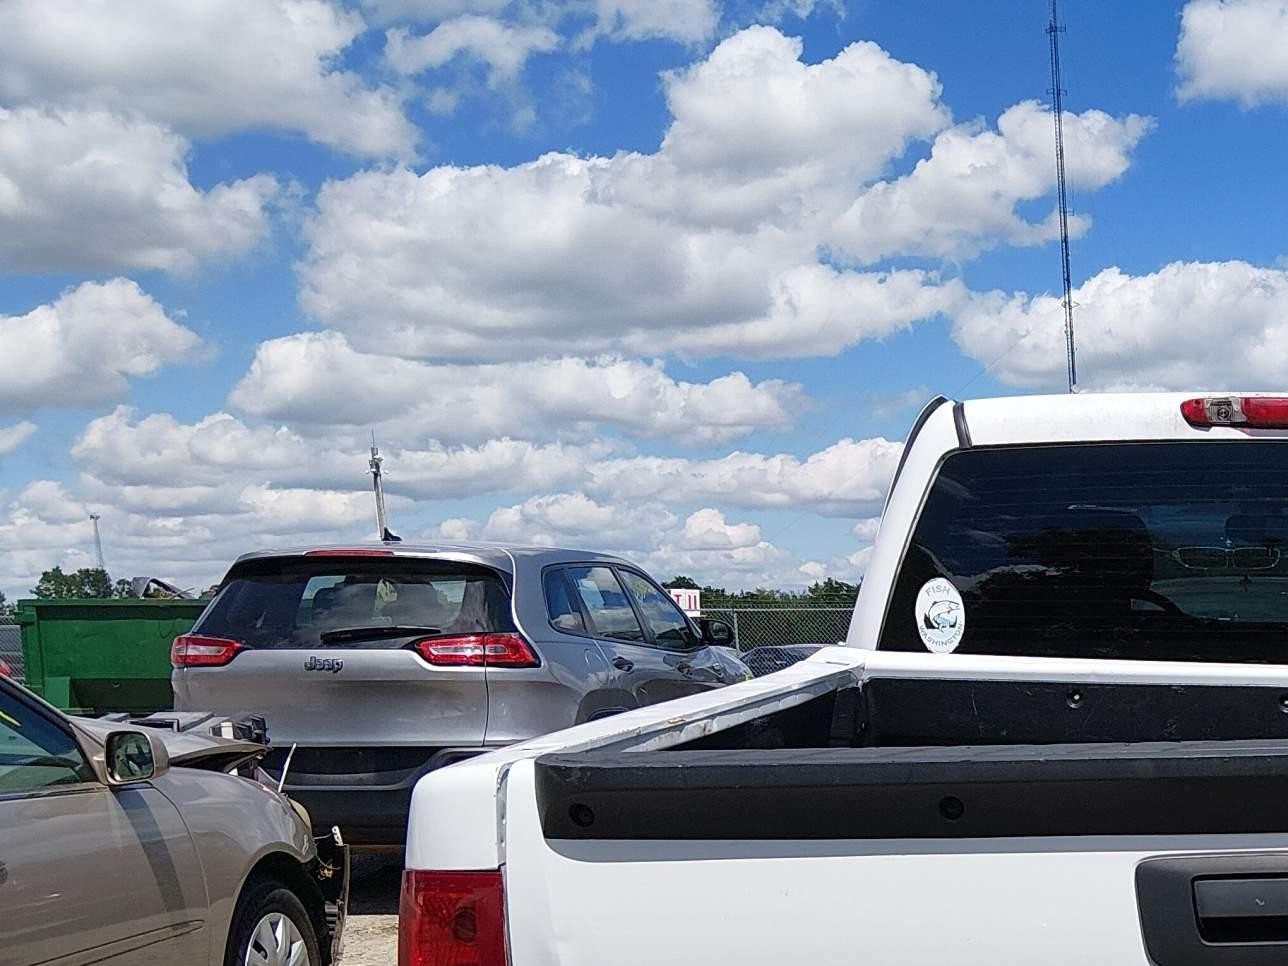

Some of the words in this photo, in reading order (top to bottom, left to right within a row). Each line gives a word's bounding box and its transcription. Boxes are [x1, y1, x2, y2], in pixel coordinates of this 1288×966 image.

[925, 585, 951, 597] FISH
[919, 622, 964, 648] WASHINGTON
[304, 656, 344, 673] Jeep
